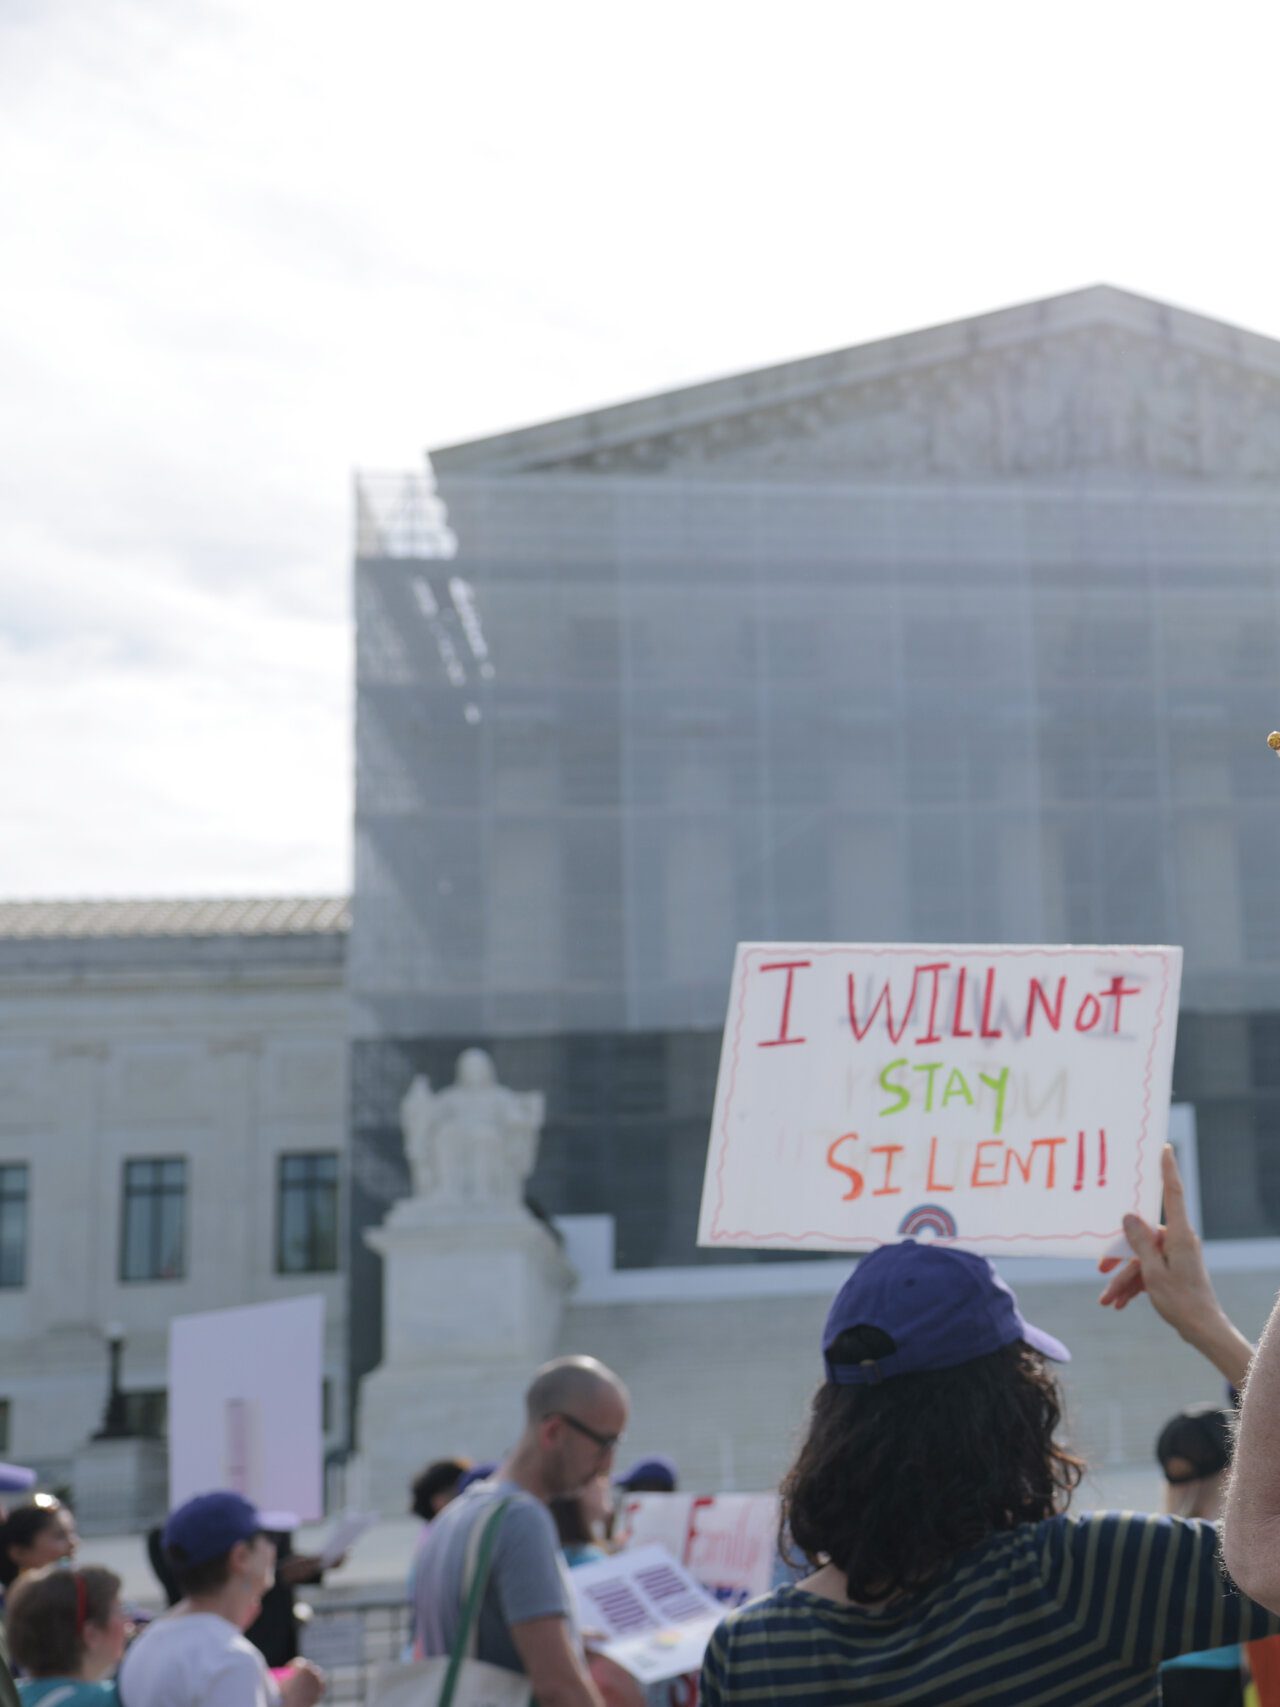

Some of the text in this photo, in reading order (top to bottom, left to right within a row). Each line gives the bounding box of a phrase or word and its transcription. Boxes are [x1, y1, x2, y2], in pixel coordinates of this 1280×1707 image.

[757, 961, 812, 1048] I
[847, 961, 1003, 1046] WILL
[878, 1057, 1009, 1134] STAY
[826, 1128, 1107, 1201] SILENT!!
